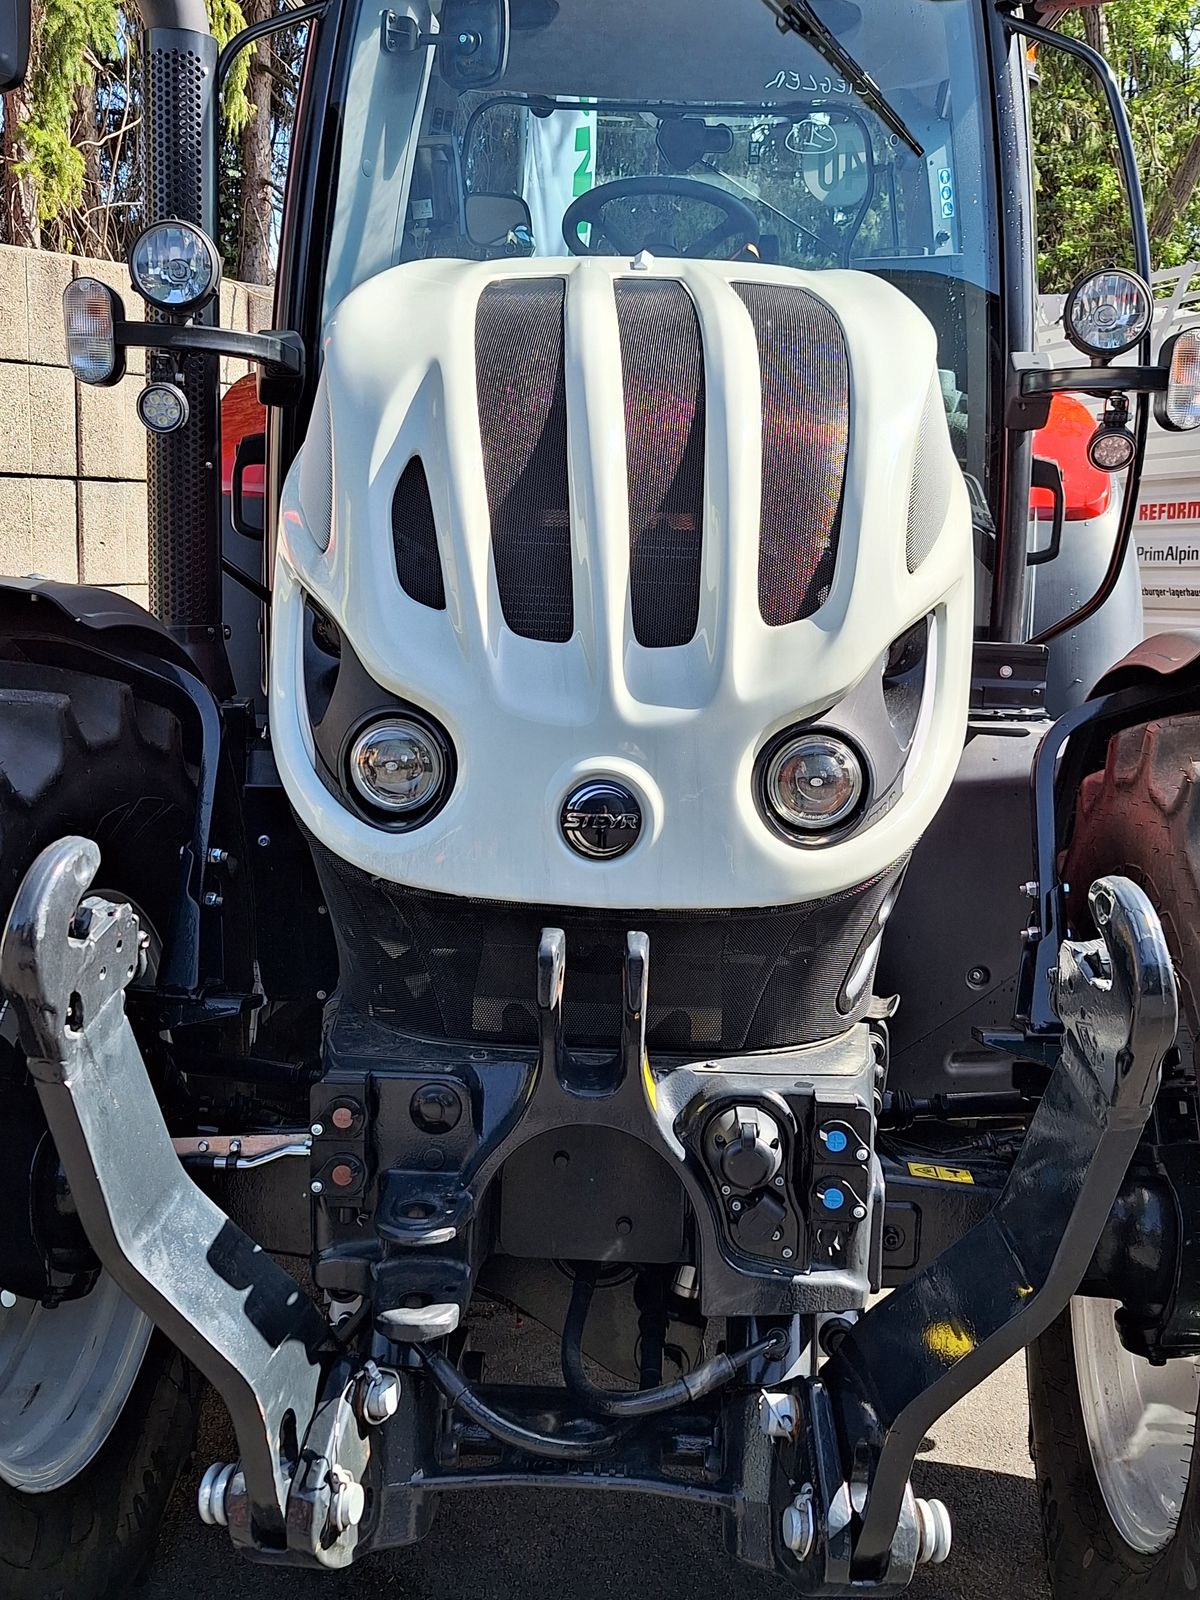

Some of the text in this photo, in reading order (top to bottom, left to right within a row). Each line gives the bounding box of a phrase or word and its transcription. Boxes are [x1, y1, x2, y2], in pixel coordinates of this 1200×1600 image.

[1139, 501, 1200, 521] REFORM
[1136, 545, 1199, 565] PrimAlpin
[563, 812, 640, 829] STEYR
